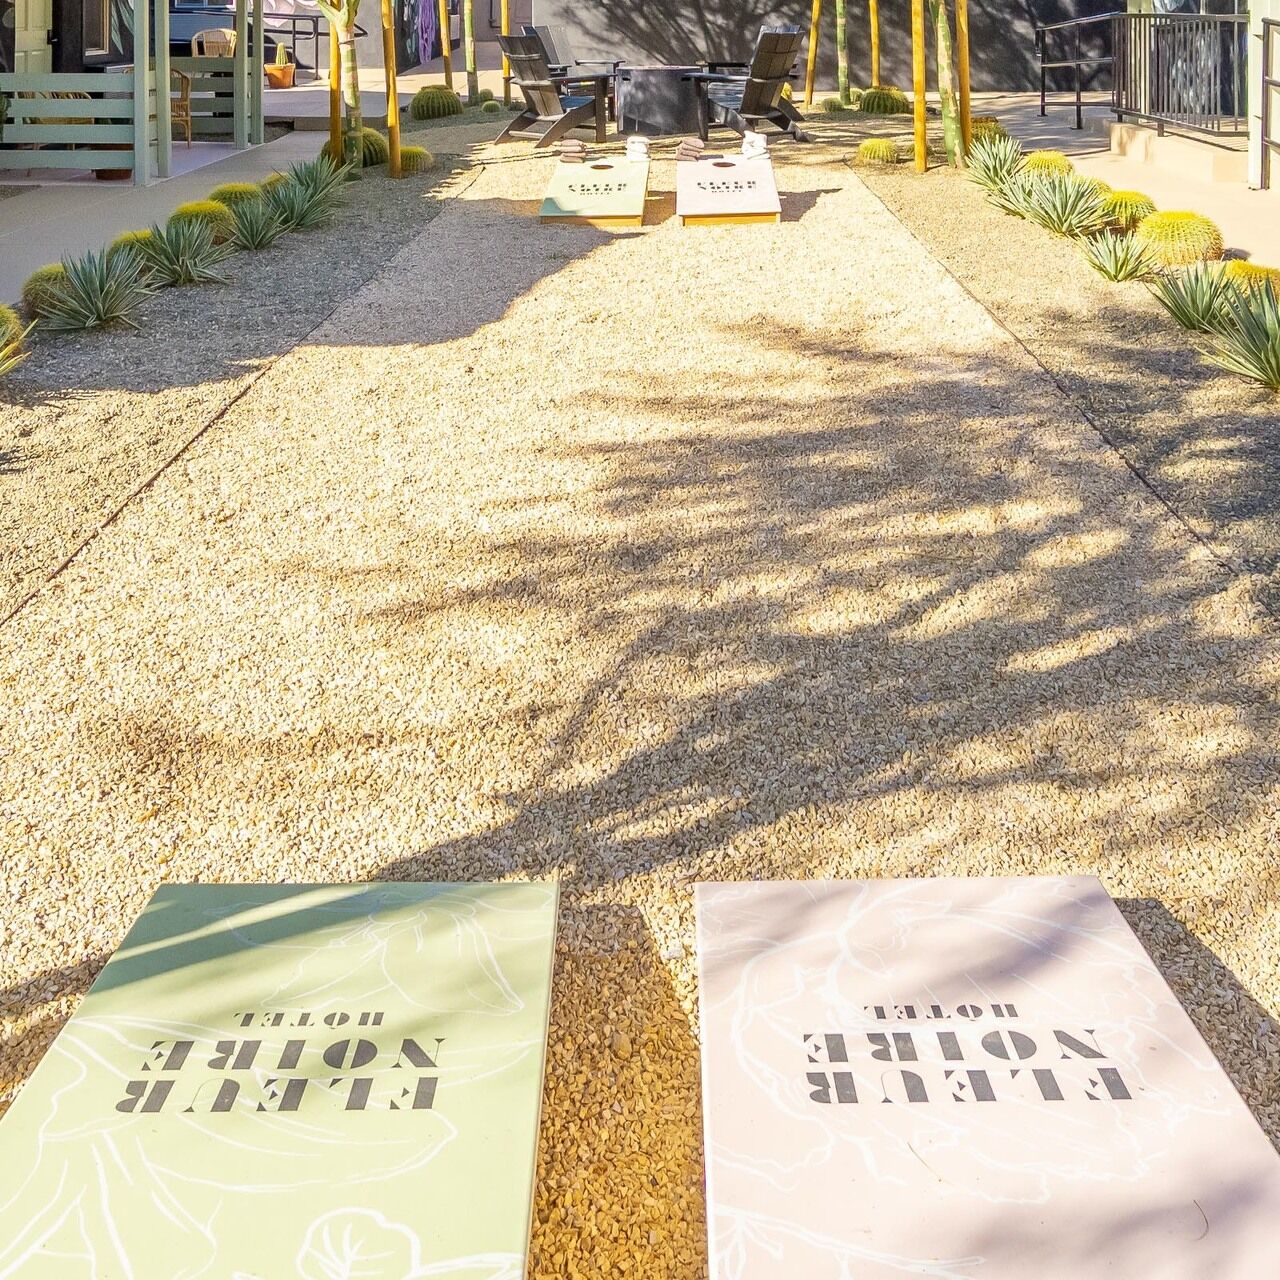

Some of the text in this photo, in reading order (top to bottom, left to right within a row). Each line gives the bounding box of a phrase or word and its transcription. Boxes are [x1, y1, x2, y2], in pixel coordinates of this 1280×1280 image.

[233, 1012, 385, 1030] HOTEL
[863, 1004, 1019, 1022] HOTEL
[141, 1038, 446, 1071] NOIRE
[803, 1029, 1108, 1063] NOIRE
[115, 1077, 439, 1113] FLEUR
[806, 1067, 1133, 1104] FLEUR
